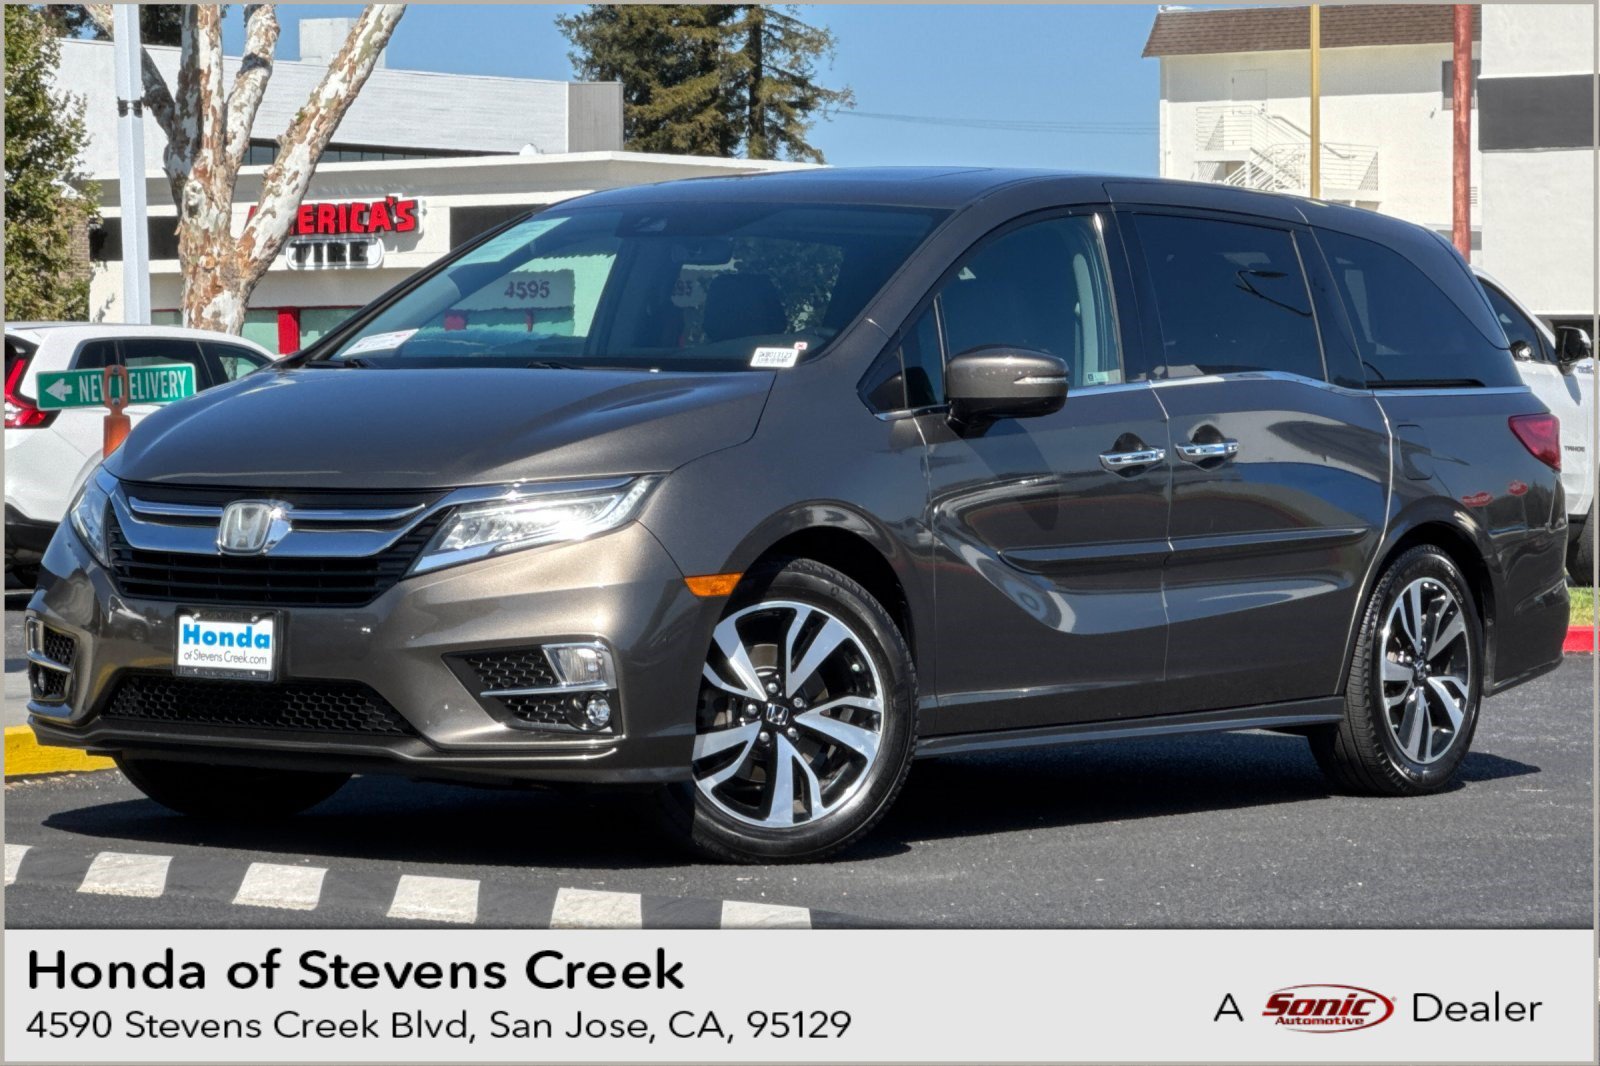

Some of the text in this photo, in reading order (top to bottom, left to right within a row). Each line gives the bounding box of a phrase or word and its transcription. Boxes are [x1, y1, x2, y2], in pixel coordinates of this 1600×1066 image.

[245, 196, 417, 235] ERICA'S
[290, 241, 369, 263] TIRE
[504, 280, 550, 299] 4595
[1564, 445, 1585, 453] TAHOE
[183, 624, 270, 649] Honda
[184, 649, 267, 664] of Stevens Creek.com
